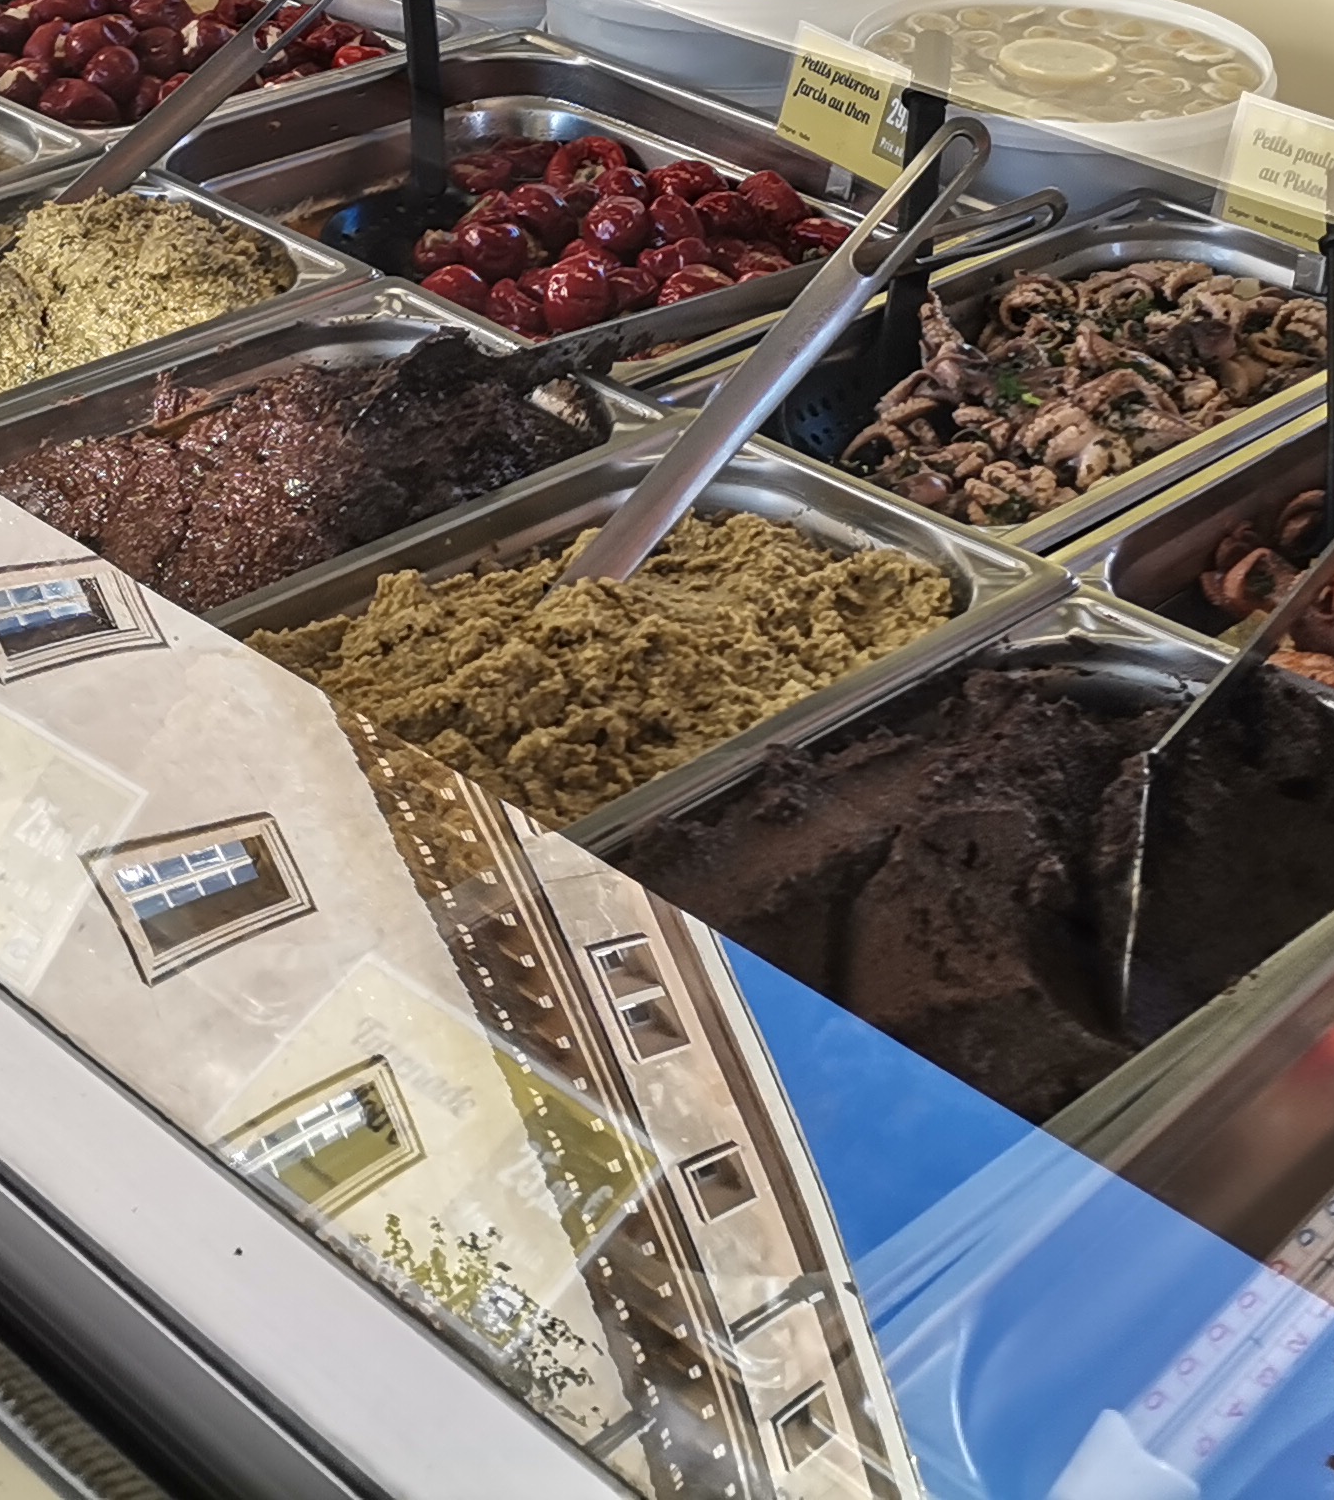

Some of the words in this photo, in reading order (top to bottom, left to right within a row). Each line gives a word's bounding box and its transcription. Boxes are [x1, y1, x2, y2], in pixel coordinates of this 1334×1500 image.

[801, 53, 831, 80] Petits
[829, 70, 881, 102] poivrons
[793, 77, 828, 106] farcis
[827, 96, 845, 114] au
[844, 96, 872, 126] thon
[1251, 127, 1294, 159] Petits
[1258, 165, 1280, 183] au
